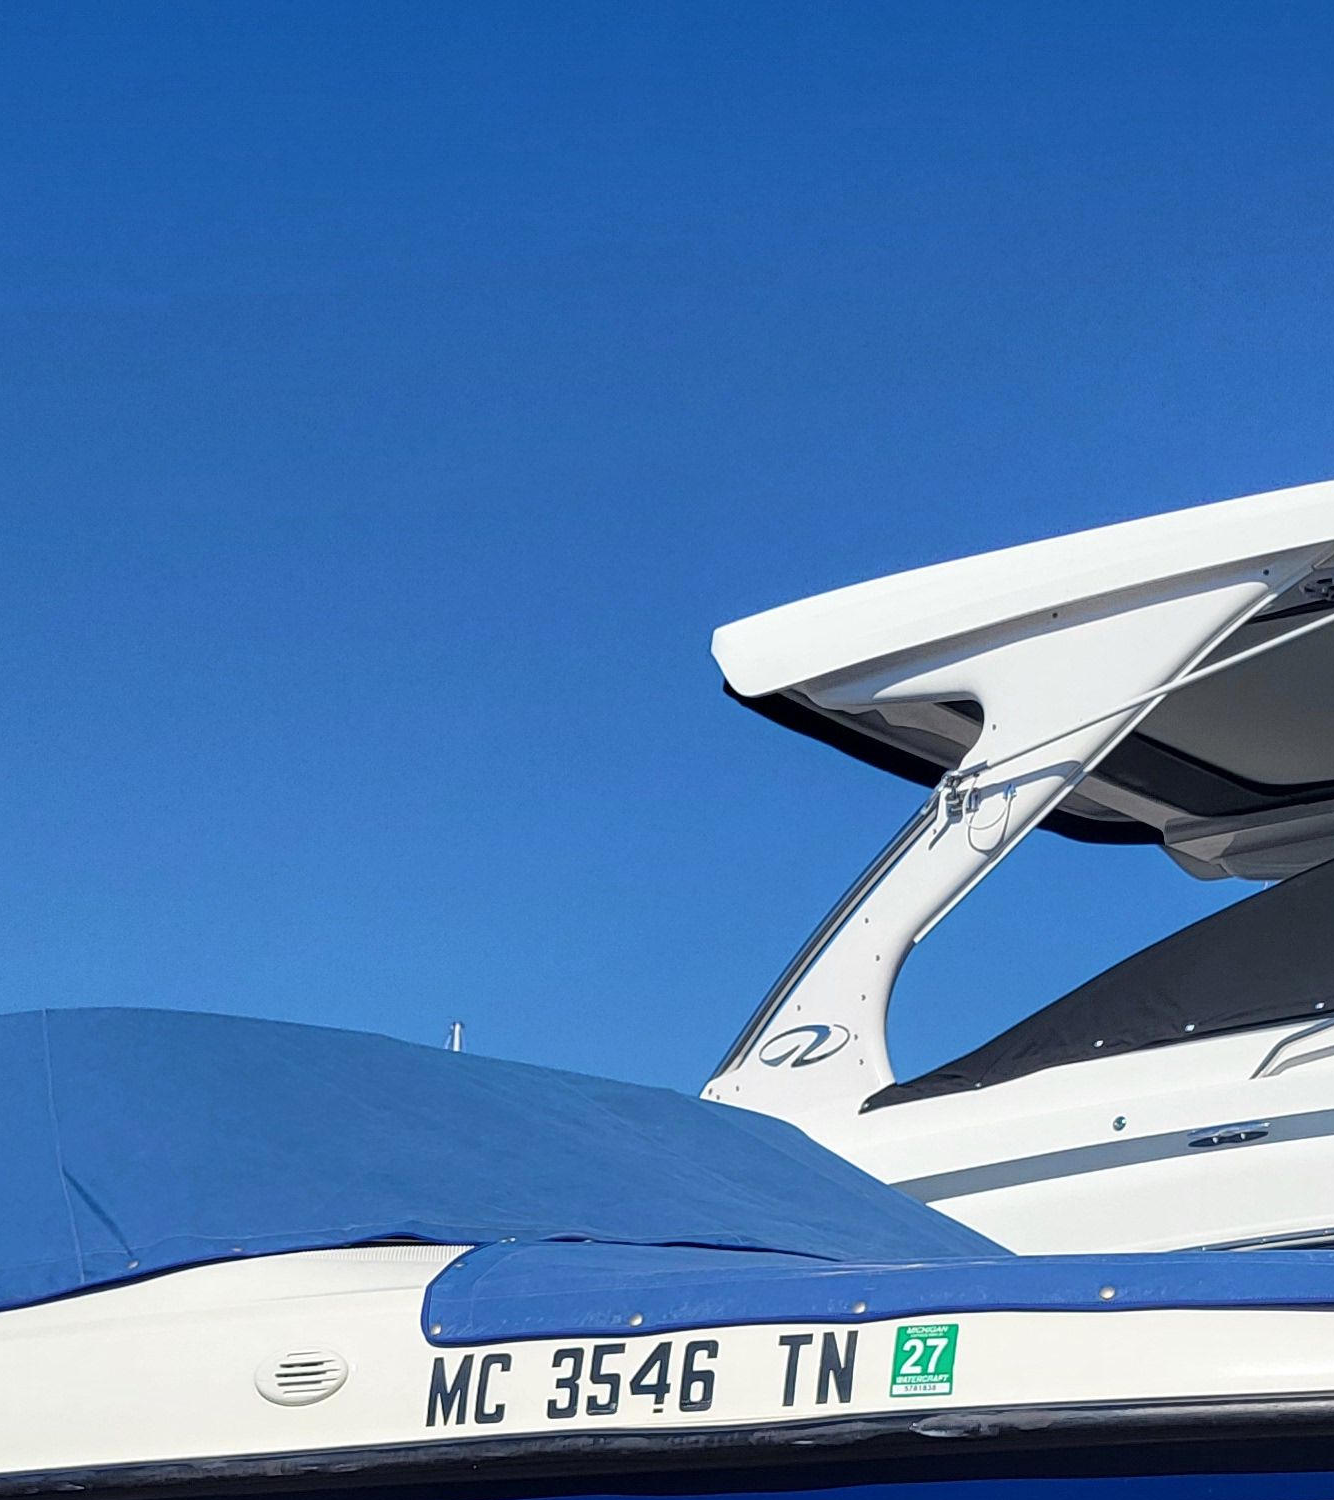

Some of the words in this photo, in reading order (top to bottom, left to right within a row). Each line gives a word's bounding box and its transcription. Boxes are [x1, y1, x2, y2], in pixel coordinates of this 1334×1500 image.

[425, 1353, 513, 1428] MC
[547, 1340, 720, 1420] 3546
[779, 1330, 859, 1407] TN
[899, 1337, 949, 1375] 27
